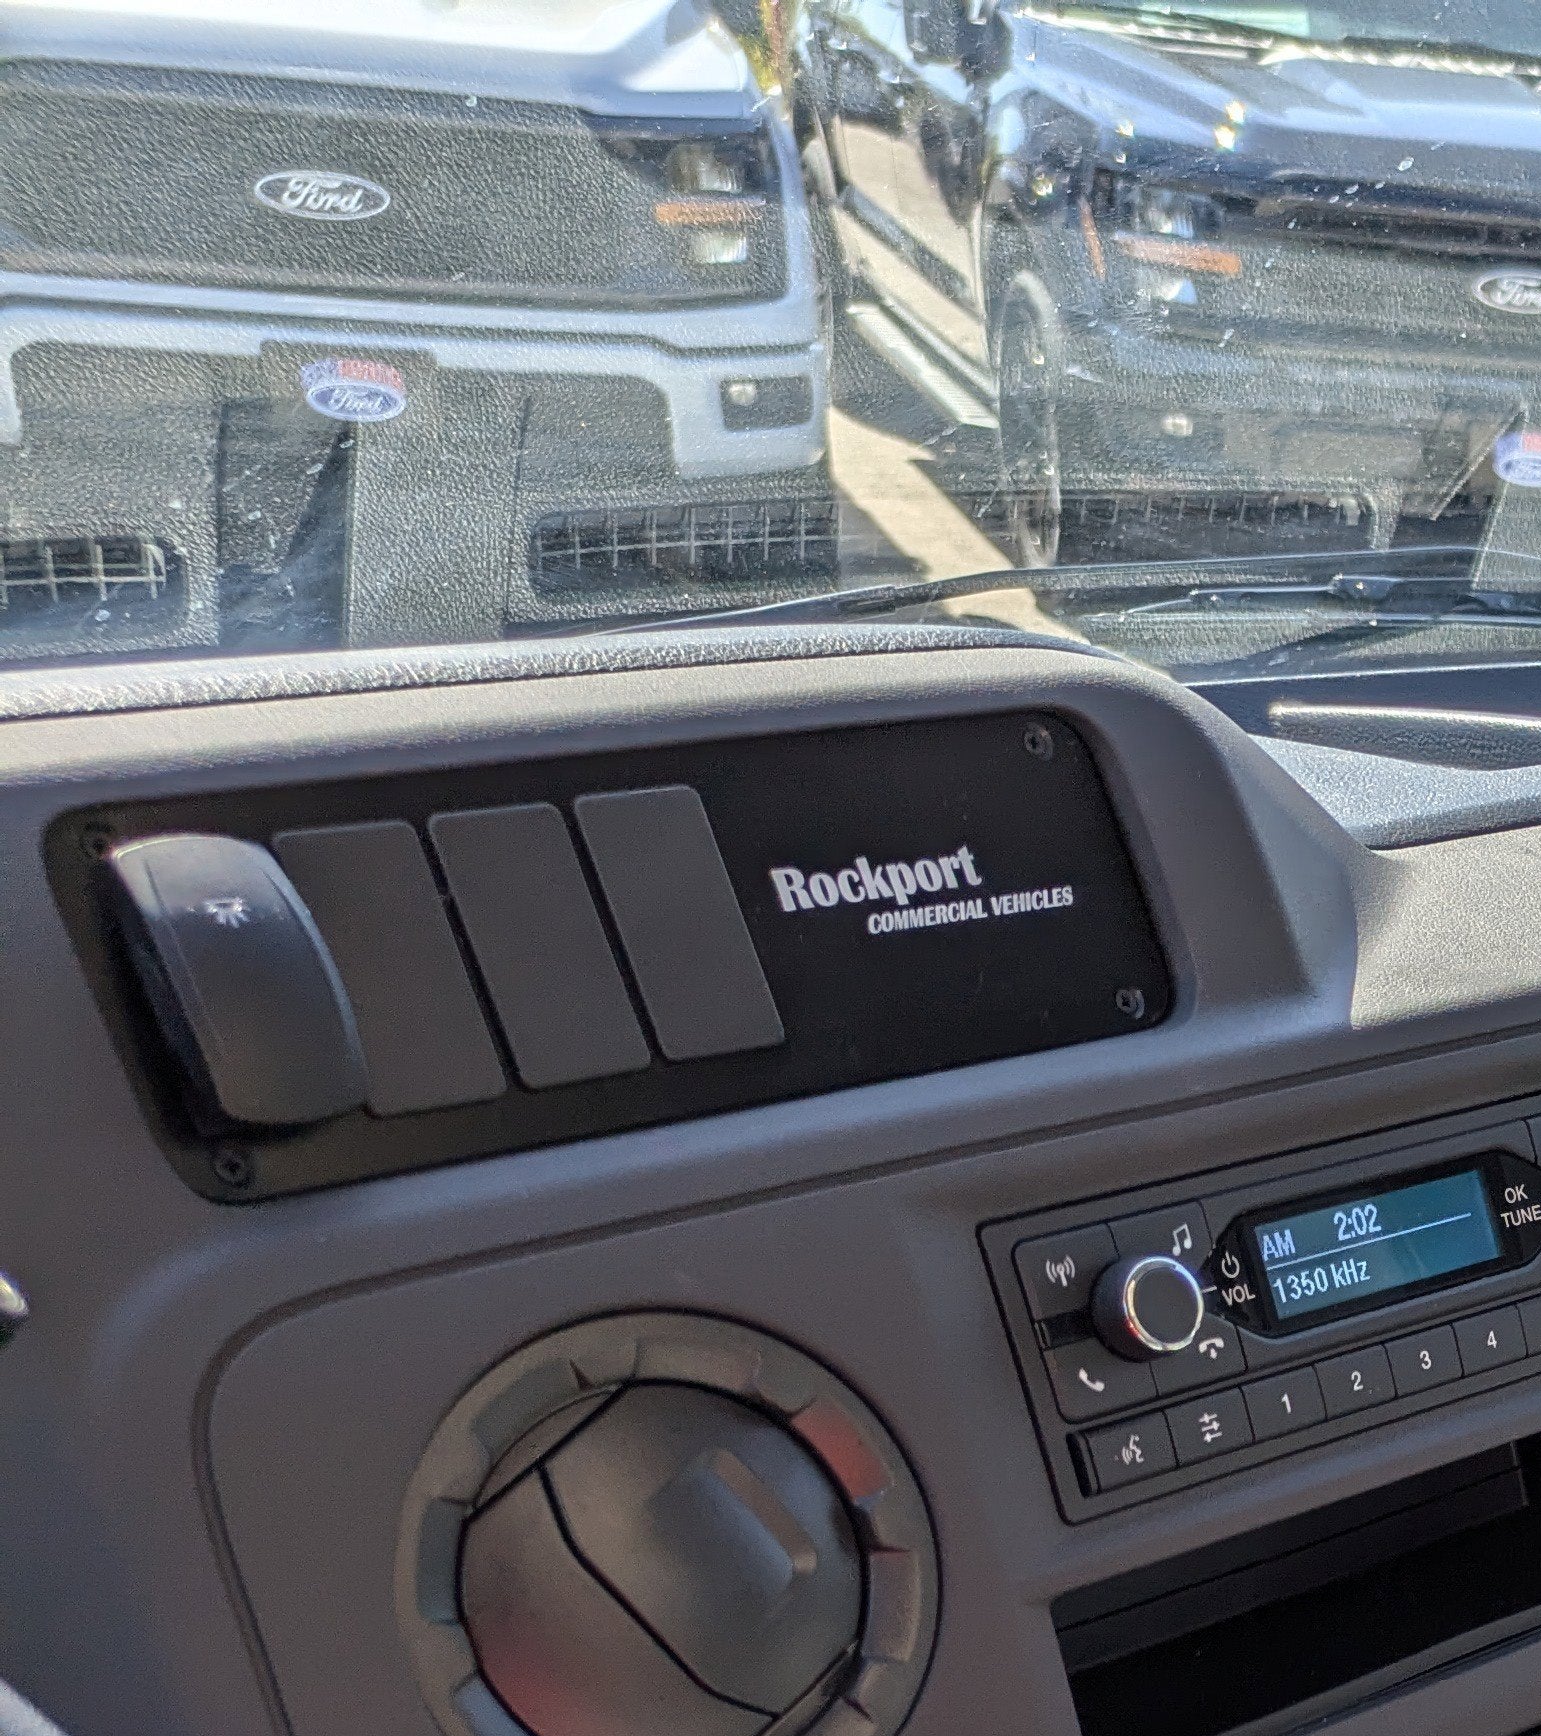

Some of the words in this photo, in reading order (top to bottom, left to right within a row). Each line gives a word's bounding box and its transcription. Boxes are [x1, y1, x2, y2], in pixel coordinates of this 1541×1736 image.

[770, 845, 982, 912] Rockport
[867, 901, 988, 935] COMMERCIAL
[990, 885, 1074, 917] VEHICLES
[1504, 1183, 1529, 1203] OK
[1261, 1228, 1296, 1262] AM
[1333, 1202, 1382, 1242] 2:02
[1272, 1267, 1329, 1304] 1350
[1332, 1258, 1371, 1290] kHz
[1221, 1282, 1256, 1307] VOL
[1486, 1330, 1498, 1349] 4
[1419, 1350, 1432, 1370] 3
[1350, 1370, 1364, 1392] 2
[1281, 1393, 1292, 1414] 1
